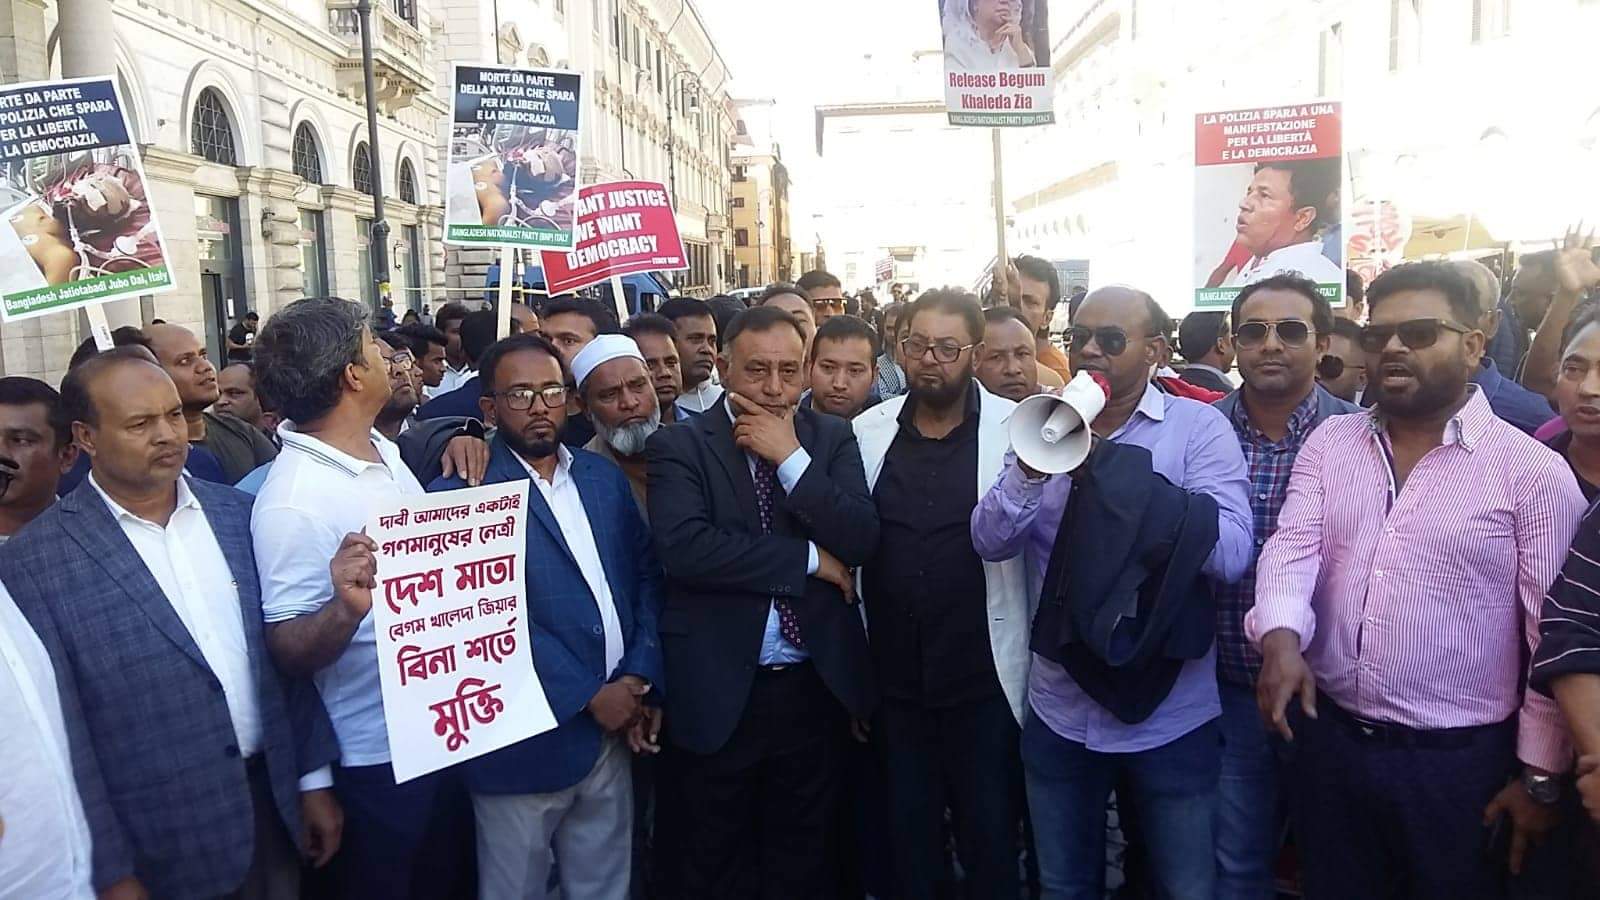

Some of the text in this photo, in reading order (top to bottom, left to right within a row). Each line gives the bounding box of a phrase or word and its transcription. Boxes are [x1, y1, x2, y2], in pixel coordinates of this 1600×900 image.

[479, 72, 555, 87] MORTE DA PARTE
[949, 72, 1045, 89] Release Begum
[24, 92, 42, 105] DA
[43, 88, 82, 102] PARTE
[460, 84, 576, 102] DELLA POLIZIA CHE SPARA
[961, 94, 1032, 109] Khaleda Zia
[0, 100, 114, 125] POLIZIA CHE SPARA
[481, 98, 551, 112] PER LA LIBERTÀ
[1203, 104, 1334, 125] LA POLIZIA SPARA A UNA
[19, 125, 36, 138] LA
[37, 116, 88, 135] LIBERTÀ
[476, 110, 556, 125] E LA DEMOCRAZIA
[1223, 119, 1317, 135] MANIFESTAZIONE
[3, 144, 21, 157] LA
[22, 133, 100, 155] DEMOCRAZIA
[1227, 130, 1313, 147] PER LA LIBERTÀ
[1222, 144, 1318, 160] E LA DEMOCRAZIA
[577, 188, 668, 216] ANT JUSTICE
[596, 213, 642, 235] WANT
[566, 235, 658, 270] DEMOCRACY
[5, 290, 57, 310] Bangladesh
[108, 277, 130, 290] Jubo
[149, 270, 168, 283] Italy
[379, 493, 521, 530] দাবী আমাদের একটাই
[382, 516, 516, 557] গণমানুষের নেত্রী
[382, 554, 516, 615] দেশ মাতা
[389, 595, 517, 642] বেগম খালেদা জিয়ার
[397, 617, 518, 686] বিনা শর্তে
[429, 678, 504, 752] মুক্তি
